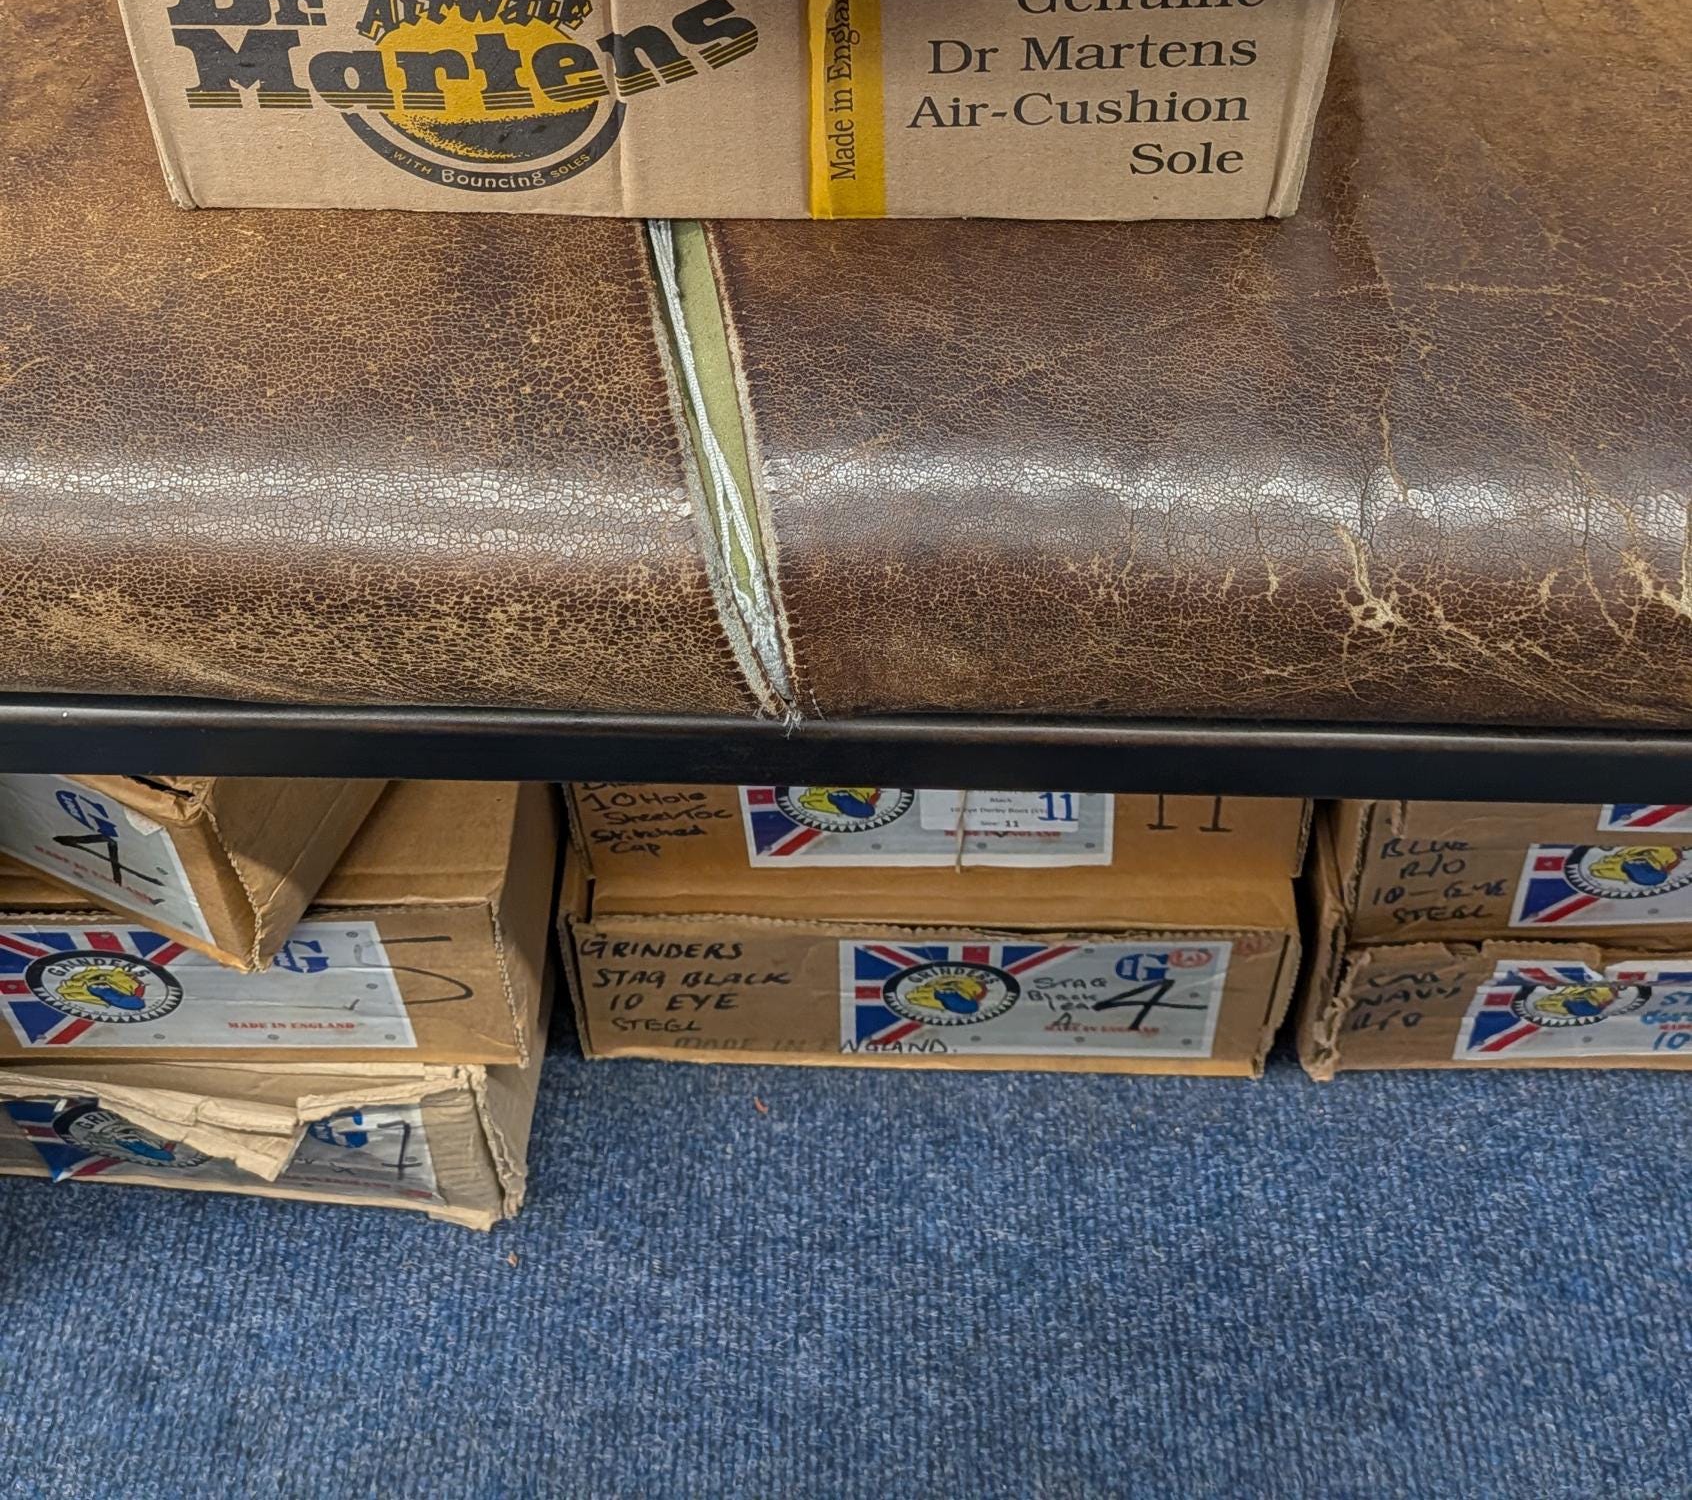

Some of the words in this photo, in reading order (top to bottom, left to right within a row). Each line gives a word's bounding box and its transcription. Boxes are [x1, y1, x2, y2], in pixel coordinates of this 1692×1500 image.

[928, 40, 999, 75] Dr
[1020, 34, 1258, 72] Martens
[829, 87, 853, 113] in
[906, 89, 1250, 129] Air-Cushion
[828, 119, 856, 181] Made
[1130, 142, 1244, 176] Sole
[393, 150, 433, 176] WITH
[441, 168, 547, 190] Bouncing
[550, 154, 592, 179] SOLES
[581, 791, 636, 813] 10
[639, 791, 708, 806] Hole
[1037, 791, 1079, 822] 11
[610, 840, 662, 859] Cap
[579, 936, 743, 963] GRINDERS
[47, 956, 151, 979] GRINDERS
[592, 968, 665, 988] STAG
[680, 970, 791, 987] BLACK
[610, 992, 643, 1011] 10
[666, 992, 740, 1011] EYE
[227, 1020, 268, 1030] MADE
[271, 1020, 288, 1030] IN
